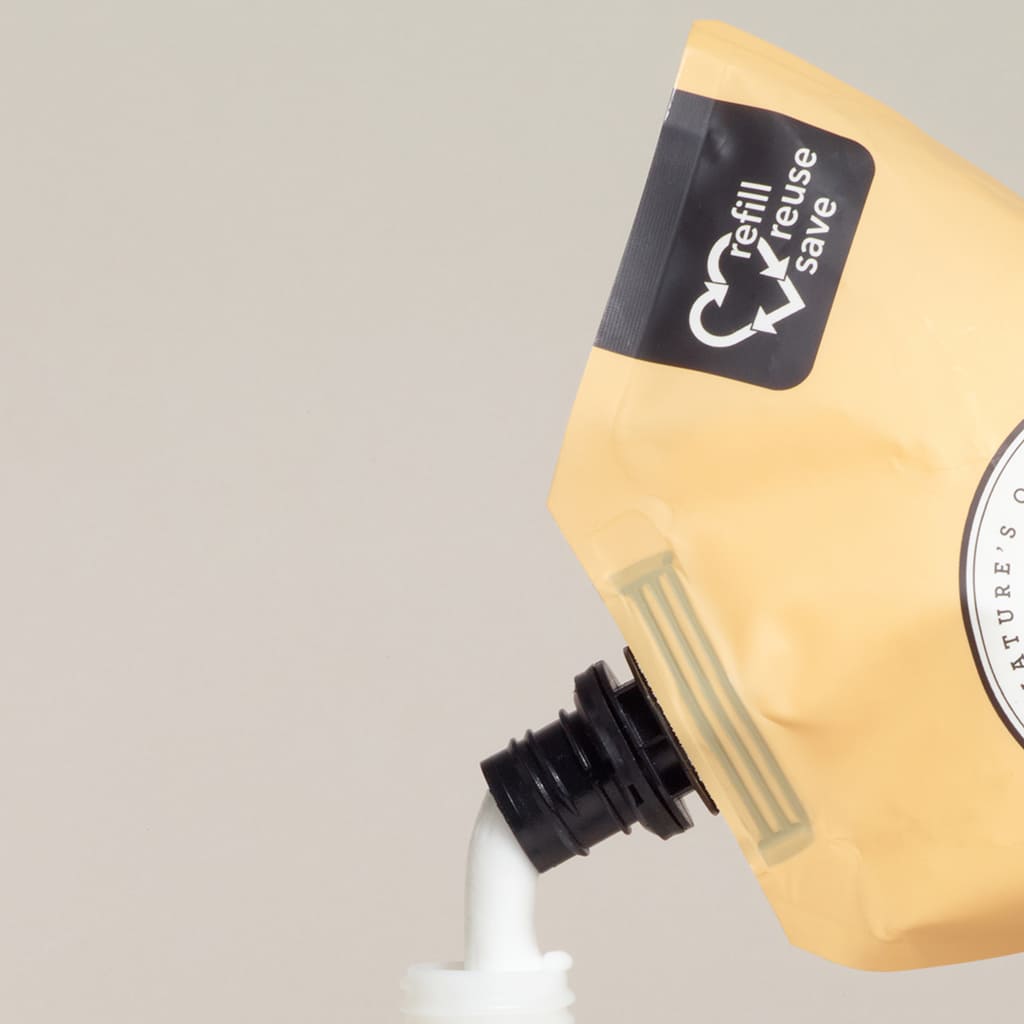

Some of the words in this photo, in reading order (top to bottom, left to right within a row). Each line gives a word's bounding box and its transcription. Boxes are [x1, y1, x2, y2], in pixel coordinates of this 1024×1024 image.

[730, 180, 773, 259] refill
[770, 147, 818, 241] reuse
[795, 196, 838, 276] save
